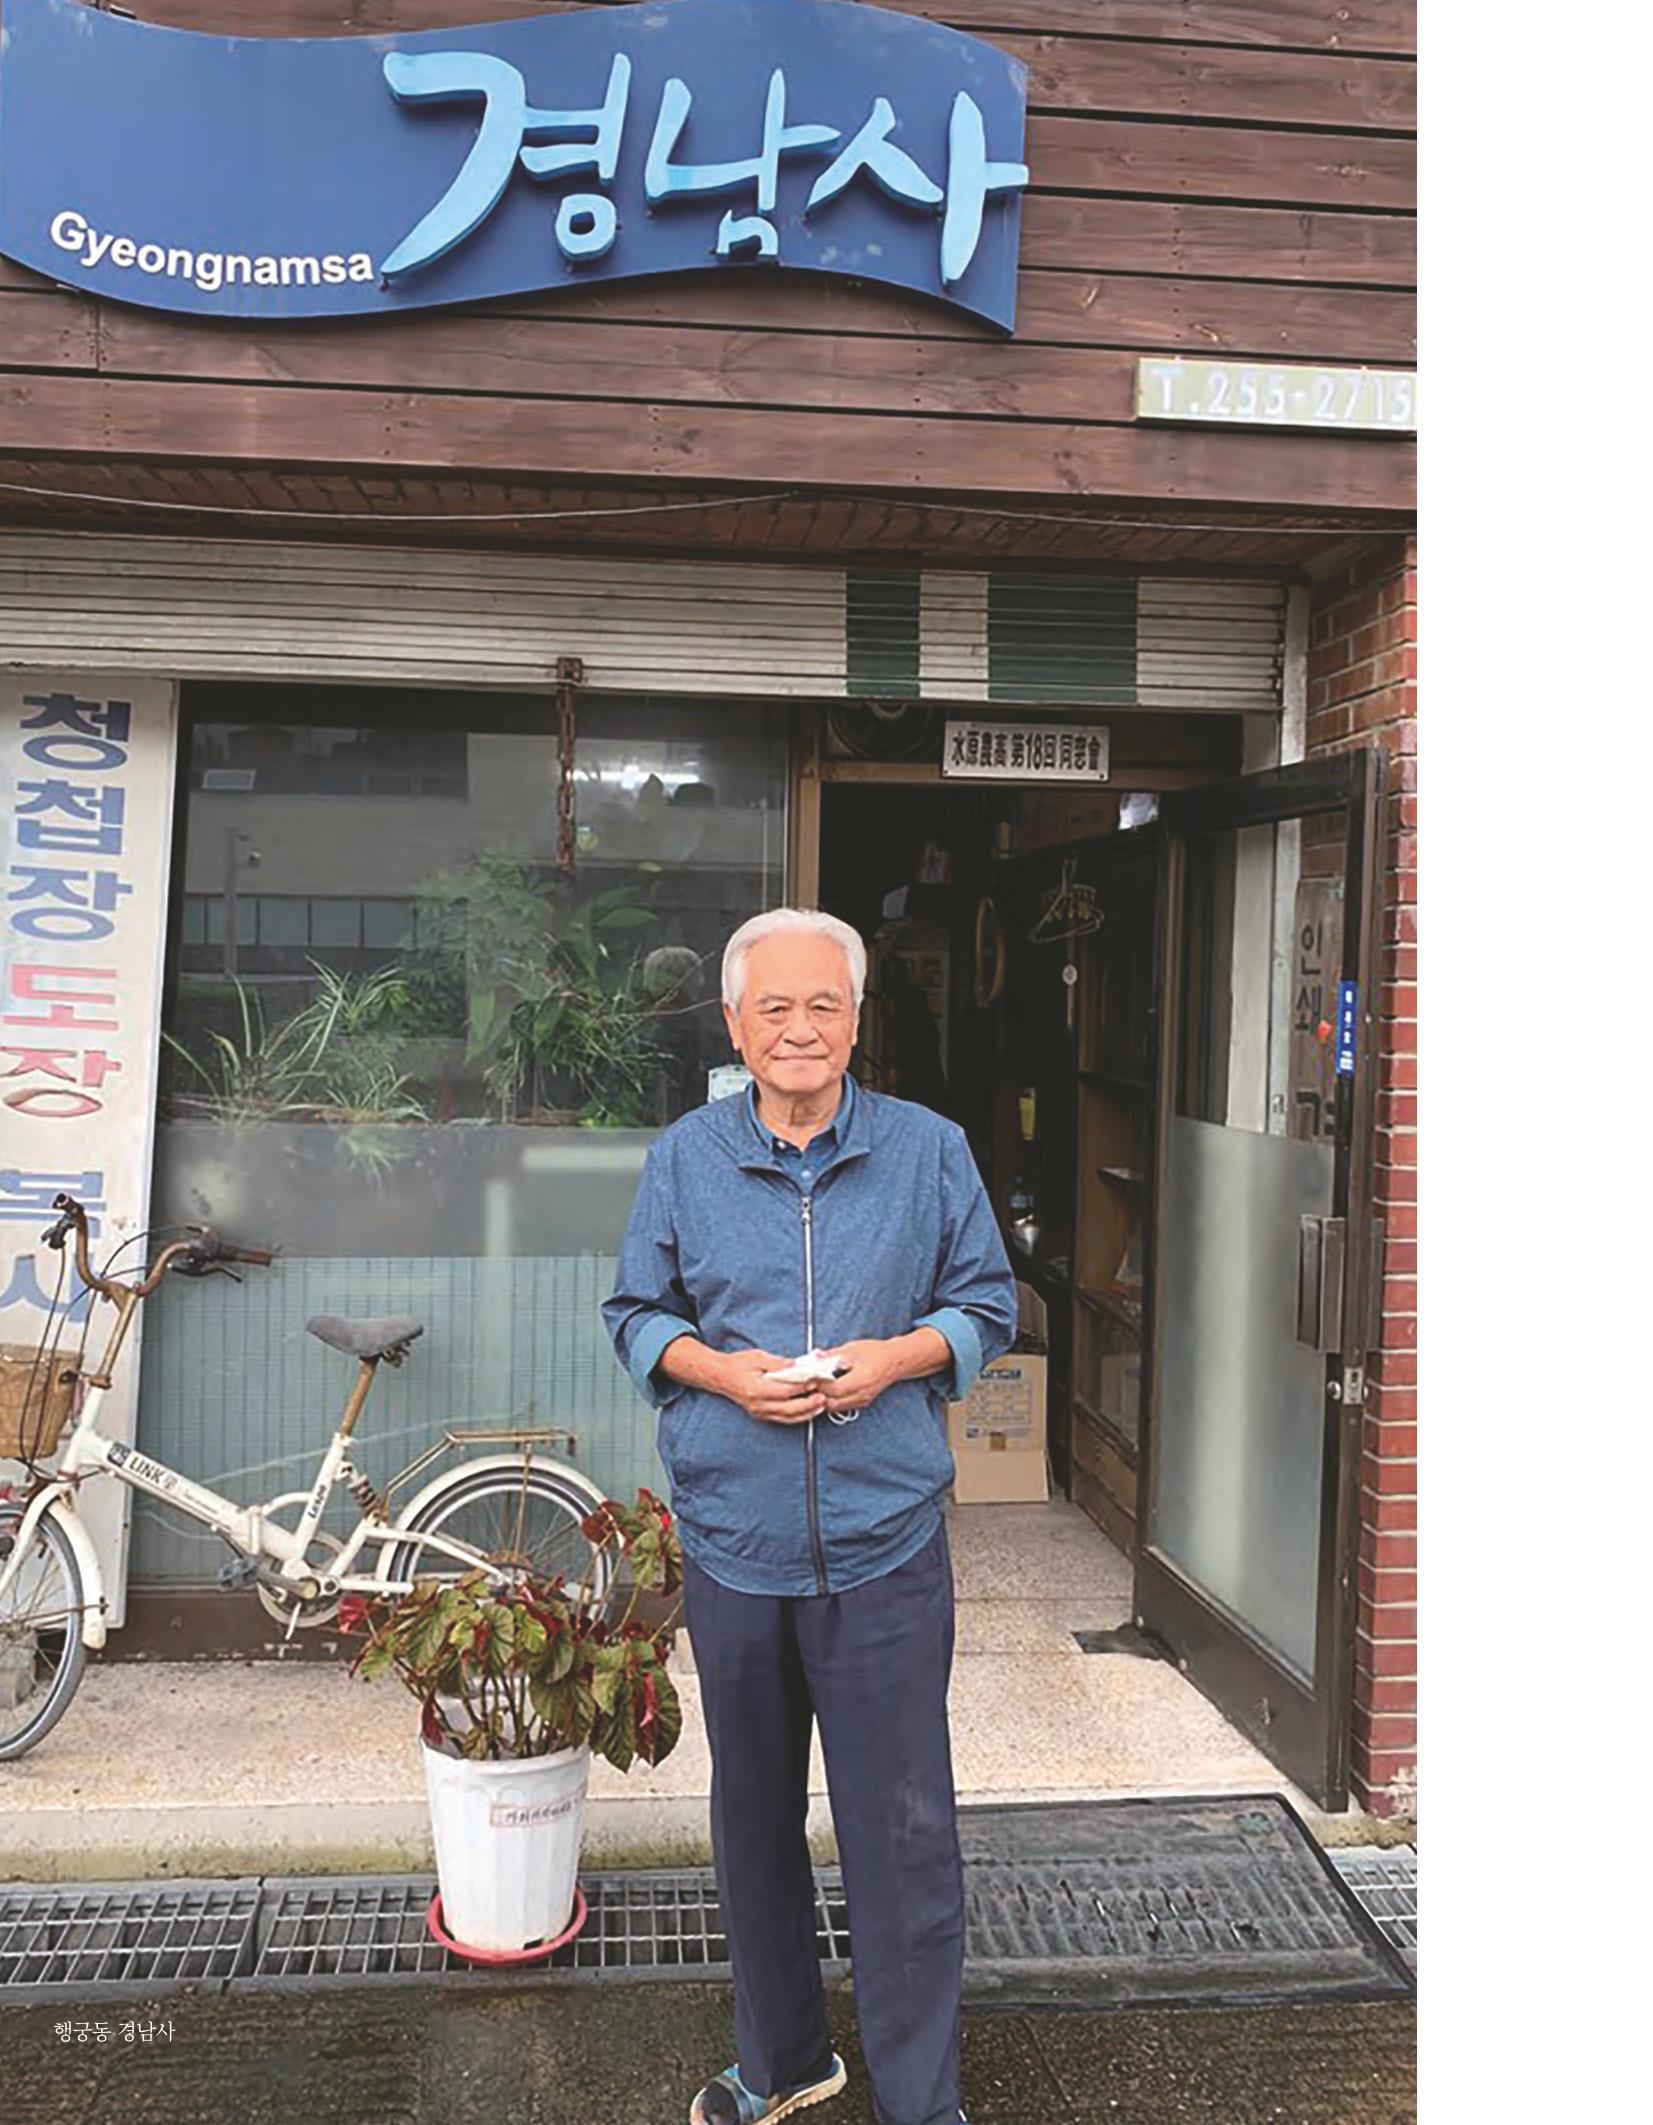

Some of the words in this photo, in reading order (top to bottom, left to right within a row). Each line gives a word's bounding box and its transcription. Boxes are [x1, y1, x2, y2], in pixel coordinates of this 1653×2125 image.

[380, 51, 1029, 285] 경남사
[49, 211, 373, 290] Gyeongnamsa
[9, 692, 133, 943] 청첩장
[0, 963, 121, 1119] 도장
[129, 1456, 165, 1484] LINK
